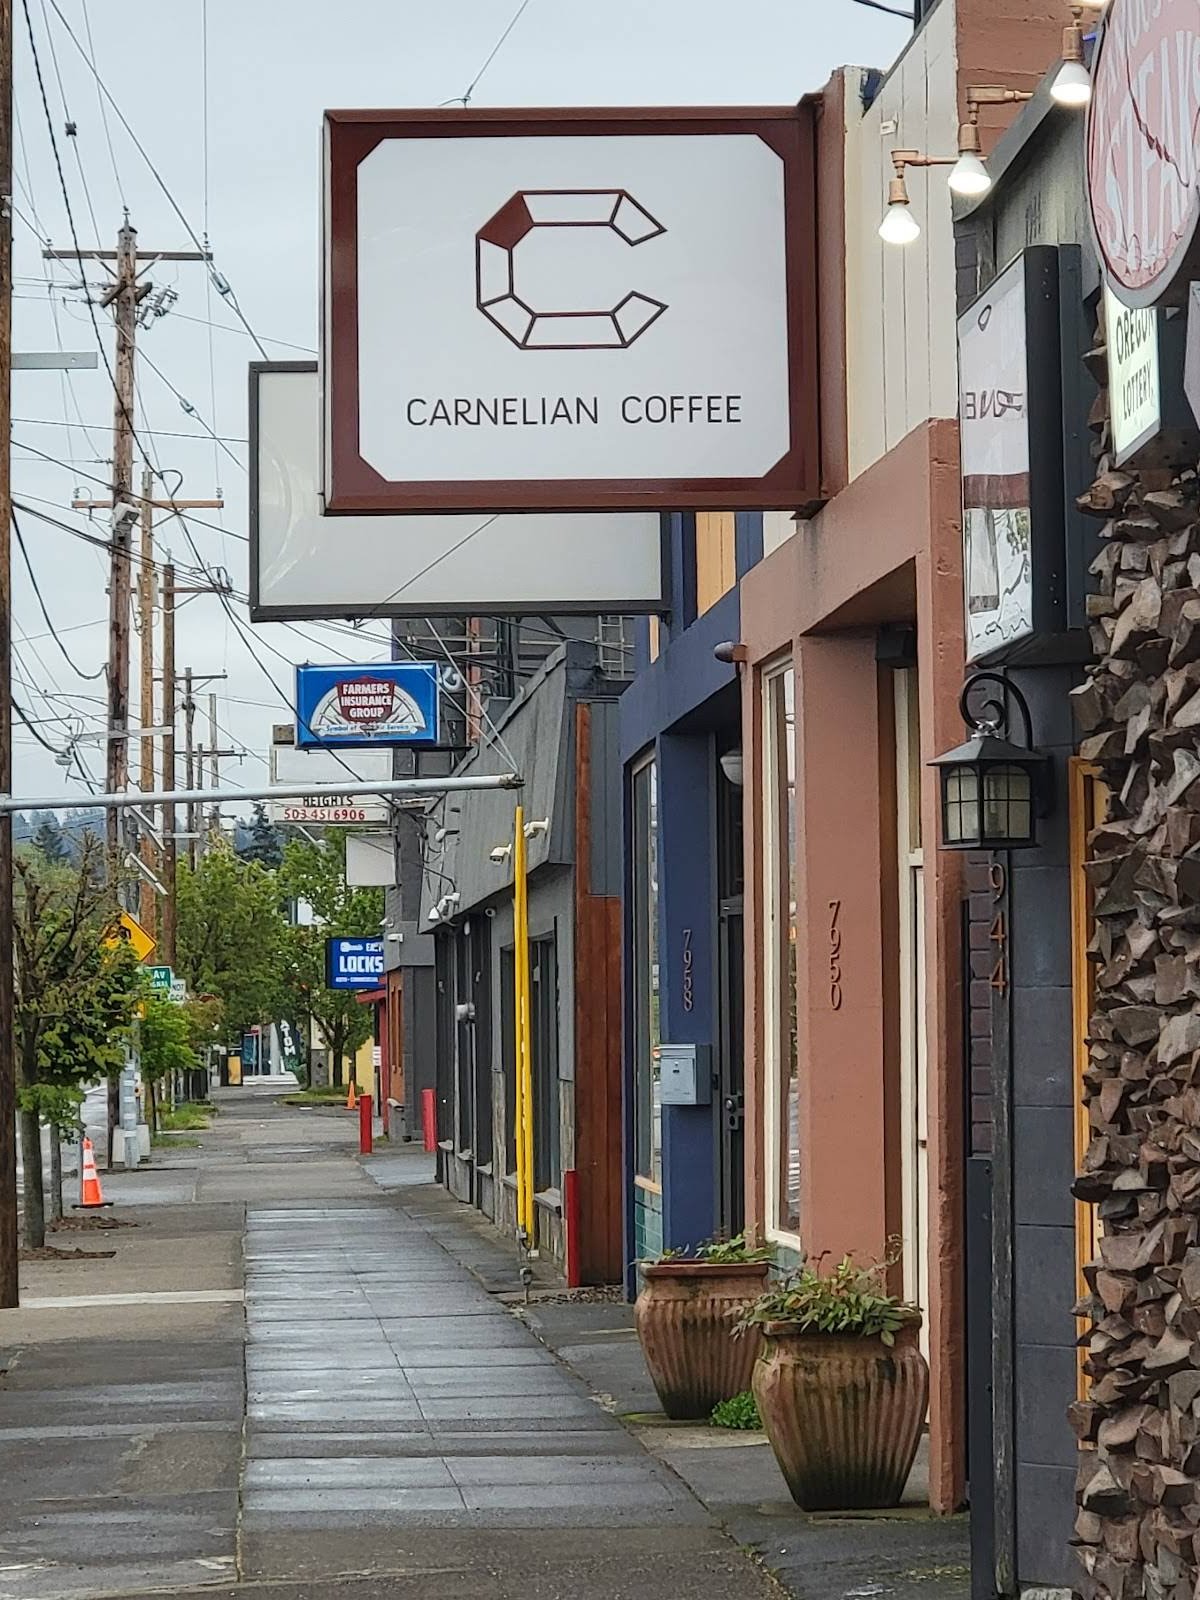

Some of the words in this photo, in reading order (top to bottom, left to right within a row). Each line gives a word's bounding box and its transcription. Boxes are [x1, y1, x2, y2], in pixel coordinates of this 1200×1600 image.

[1115, 308, 1154, 366] OREGON
[406, 396, 599, 426] CARNELIAN
[621, 394, 742, 424] COFFEE
[341, 696, 392, 707] INSURANCE
[342, 683, 390, 696] FARMERS
[349, 707, 385, 718] GROUP
[283, 808, 307, 820] 503
[334, 808, 366, 820] 6906
[989, 852, 1007, 999] 944
[339, 955, 384, 973] LOCKS
[828, 900, 842, 1011] 7950
[682, 929, 694, 1013] 7958
